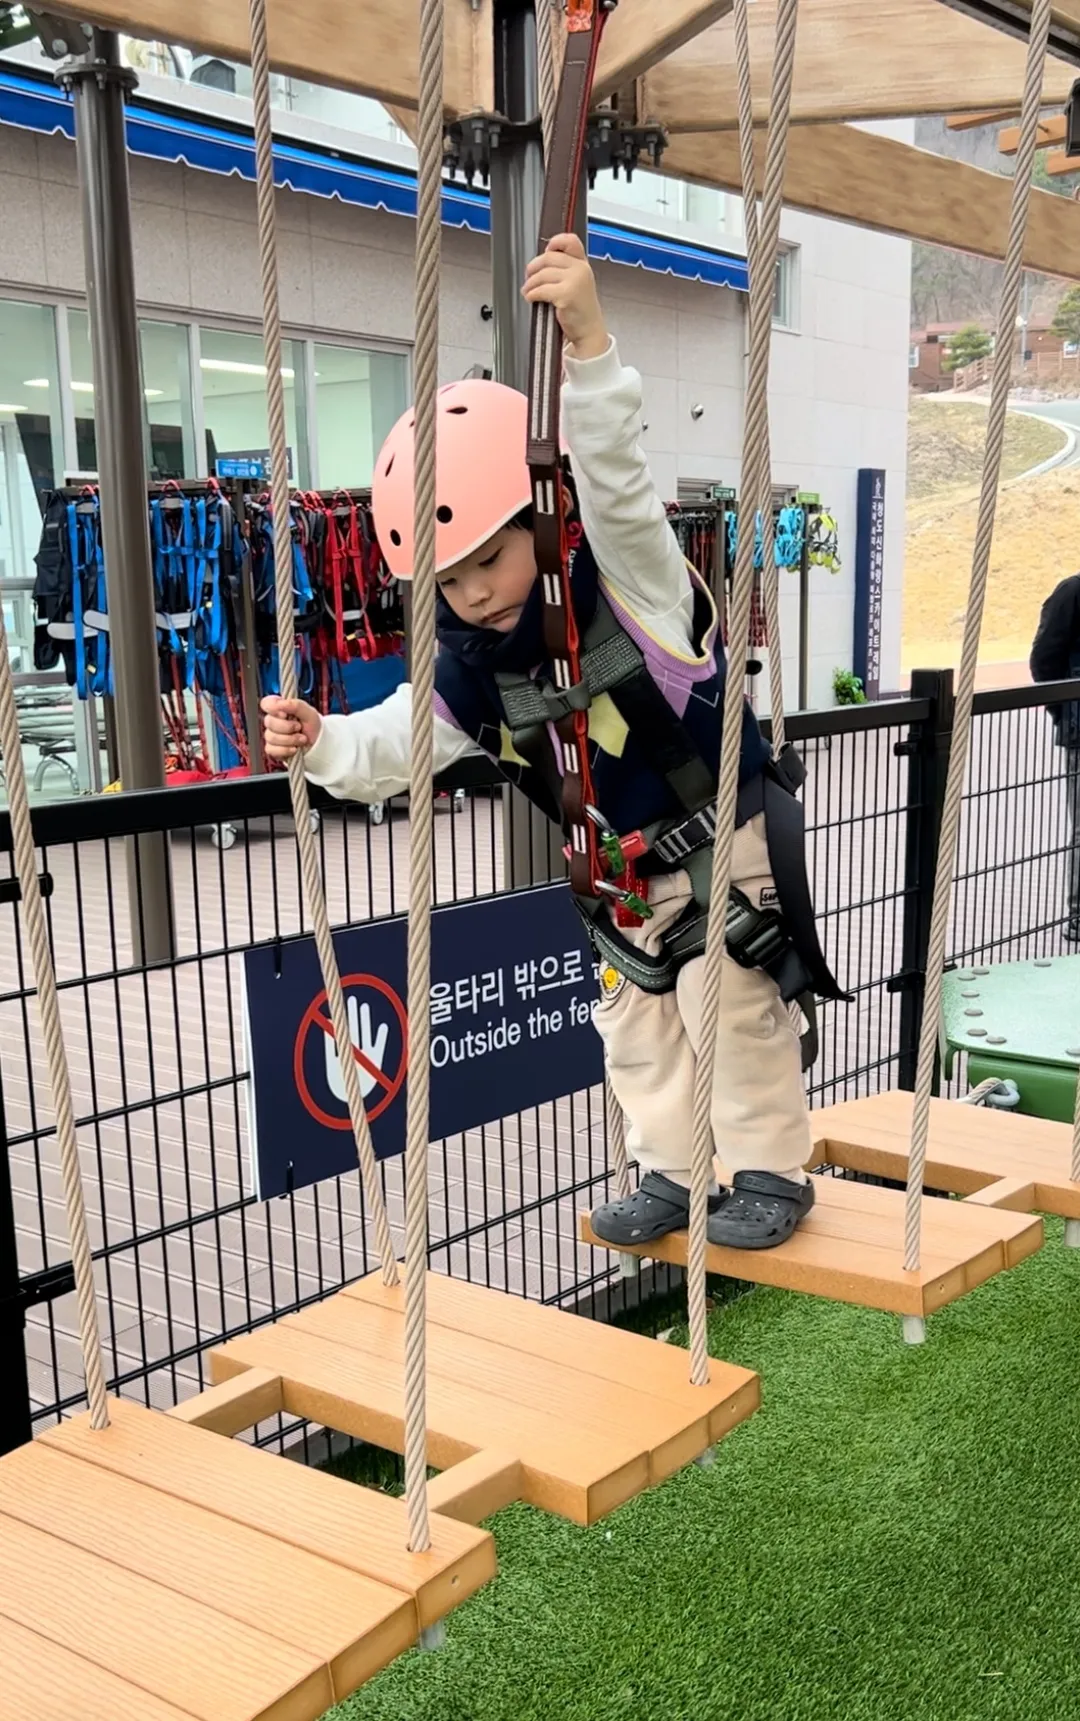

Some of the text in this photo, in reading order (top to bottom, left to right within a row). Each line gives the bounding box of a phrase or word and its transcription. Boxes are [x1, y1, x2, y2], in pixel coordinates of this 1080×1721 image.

[429, 949, 584, 1026] 울타리 밖으로
[429, 1017, 522, 1069] Outside
[527, 1007, 563, 1040] the
